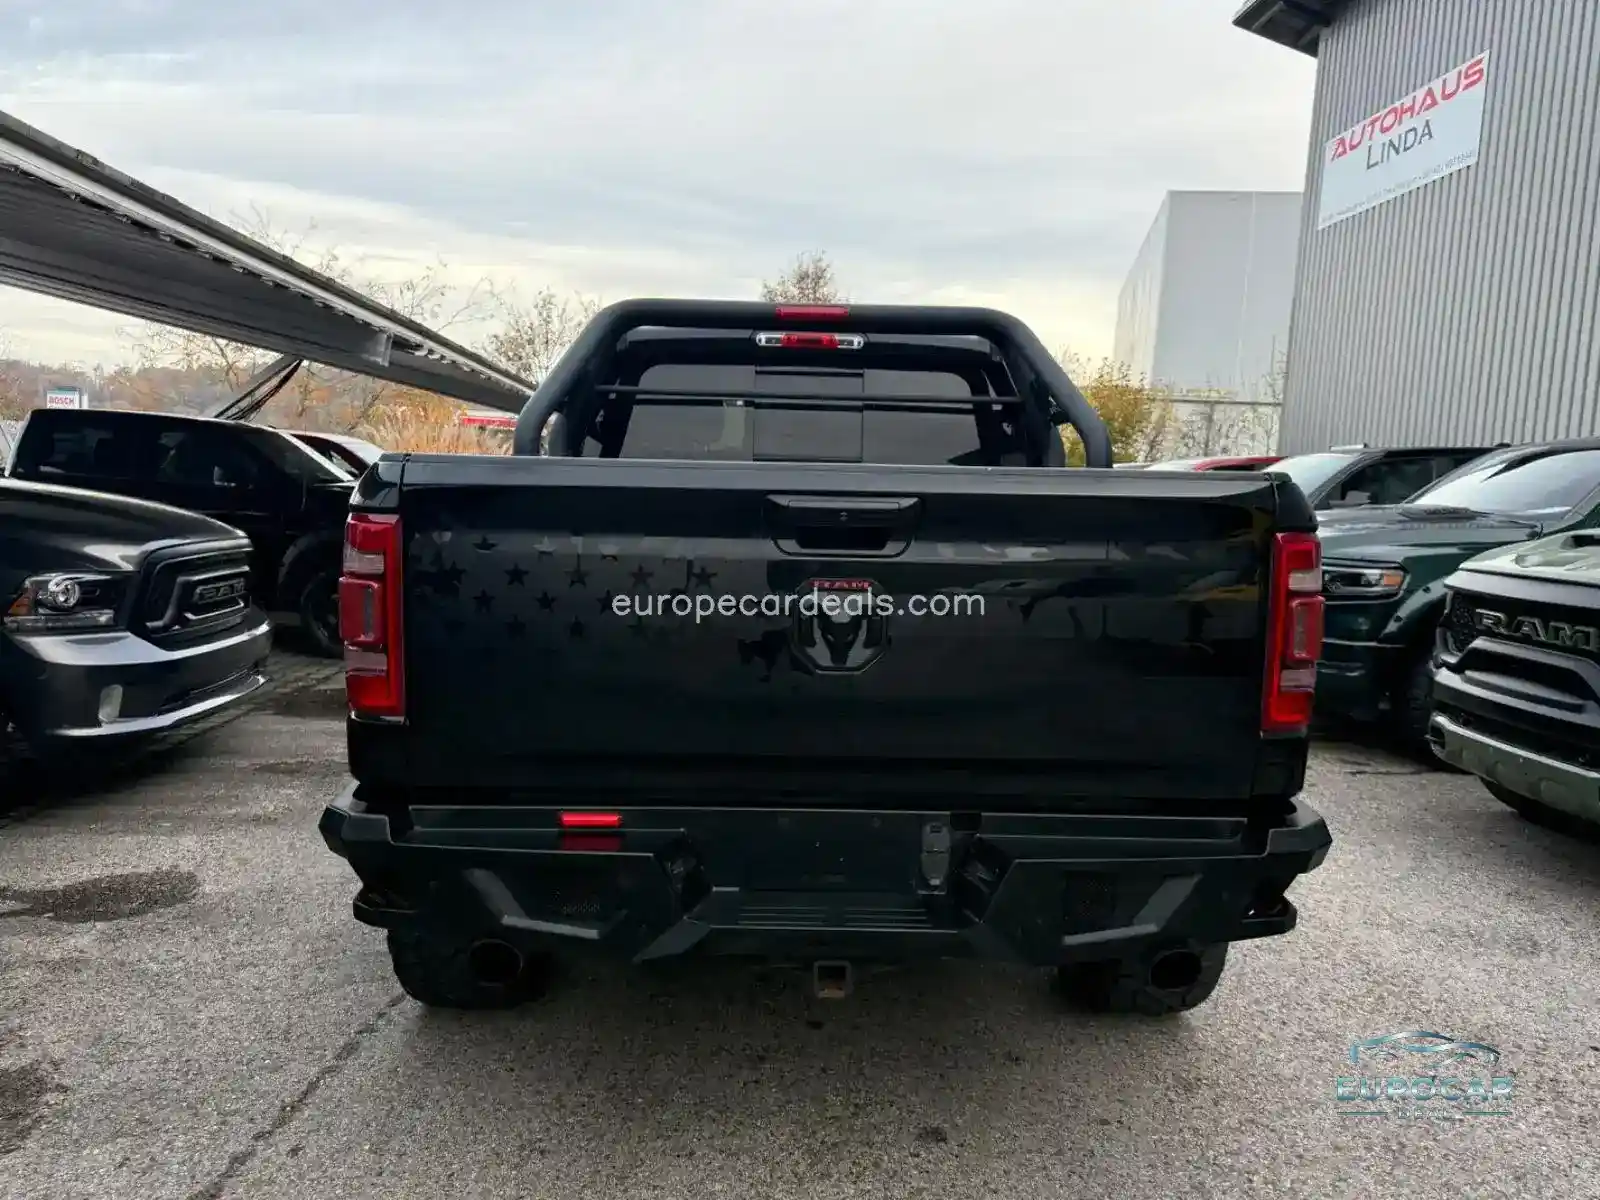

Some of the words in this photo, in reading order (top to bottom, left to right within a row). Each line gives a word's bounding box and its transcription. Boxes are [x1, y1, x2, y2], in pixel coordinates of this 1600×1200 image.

[1331, 57, 1485, 161] AUTOHAUS
[1366, 117, 1434, 170] LINDA
[1475, 607, 1600, 651] RAM
